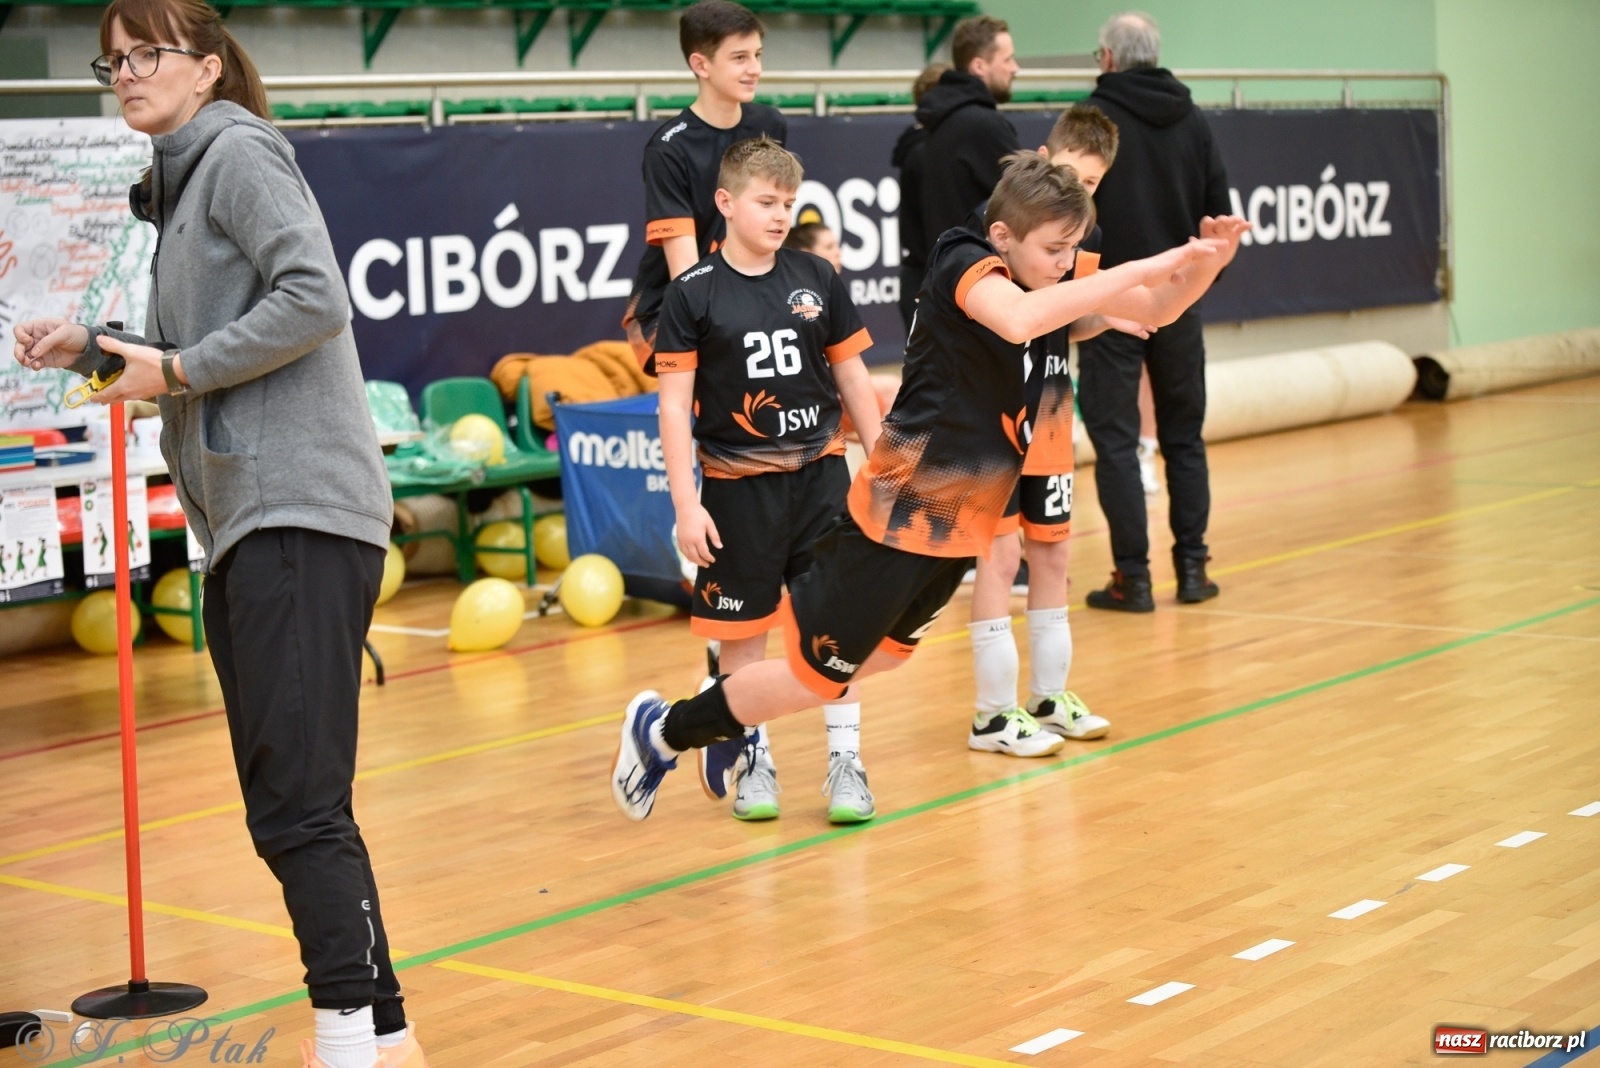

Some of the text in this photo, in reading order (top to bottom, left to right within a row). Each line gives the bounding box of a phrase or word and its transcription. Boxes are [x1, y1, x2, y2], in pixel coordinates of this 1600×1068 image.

[349, 202, 633, 322] CIBÓRZ
[743, 328, 803, 379] 26
[777, 404, 820, 437] JSW
[568, 430, 697, 471] molte
[1045, 472, 1073, 517] 28
[716, 595, 744, 612] JSW
